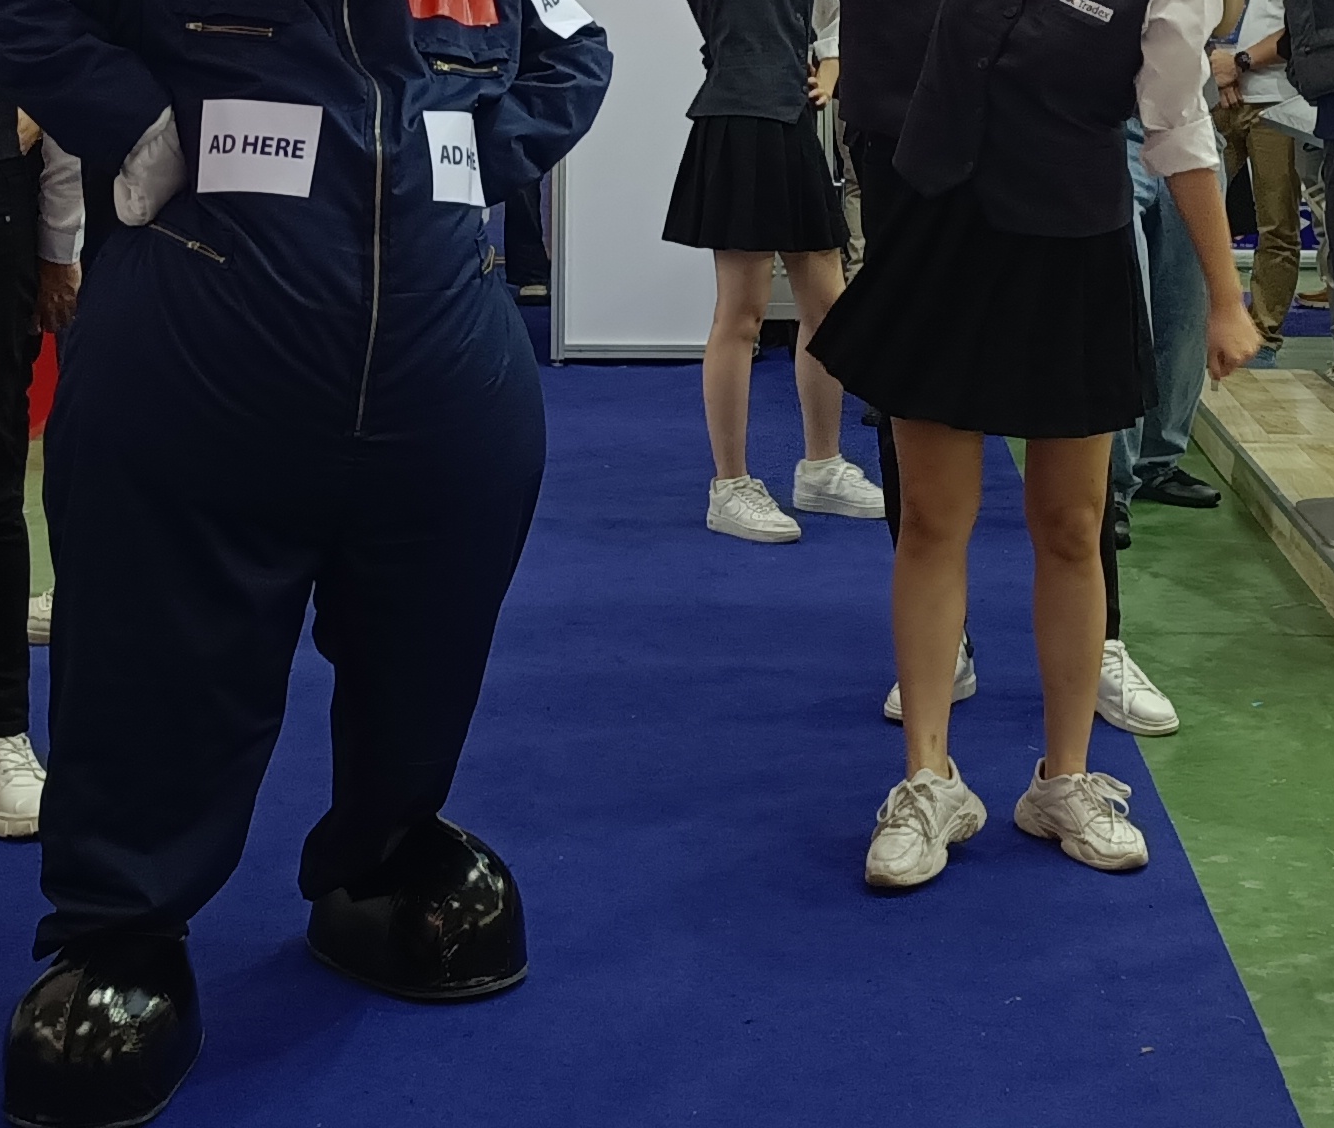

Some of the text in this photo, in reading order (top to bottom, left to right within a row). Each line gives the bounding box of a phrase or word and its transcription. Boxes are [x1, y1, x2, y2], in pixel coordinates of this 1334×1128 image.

[1078, 0, 1110, 19] Tradex
[208, 133, 306, 160] AD HERE
[439, 144, 464, 166] AD
